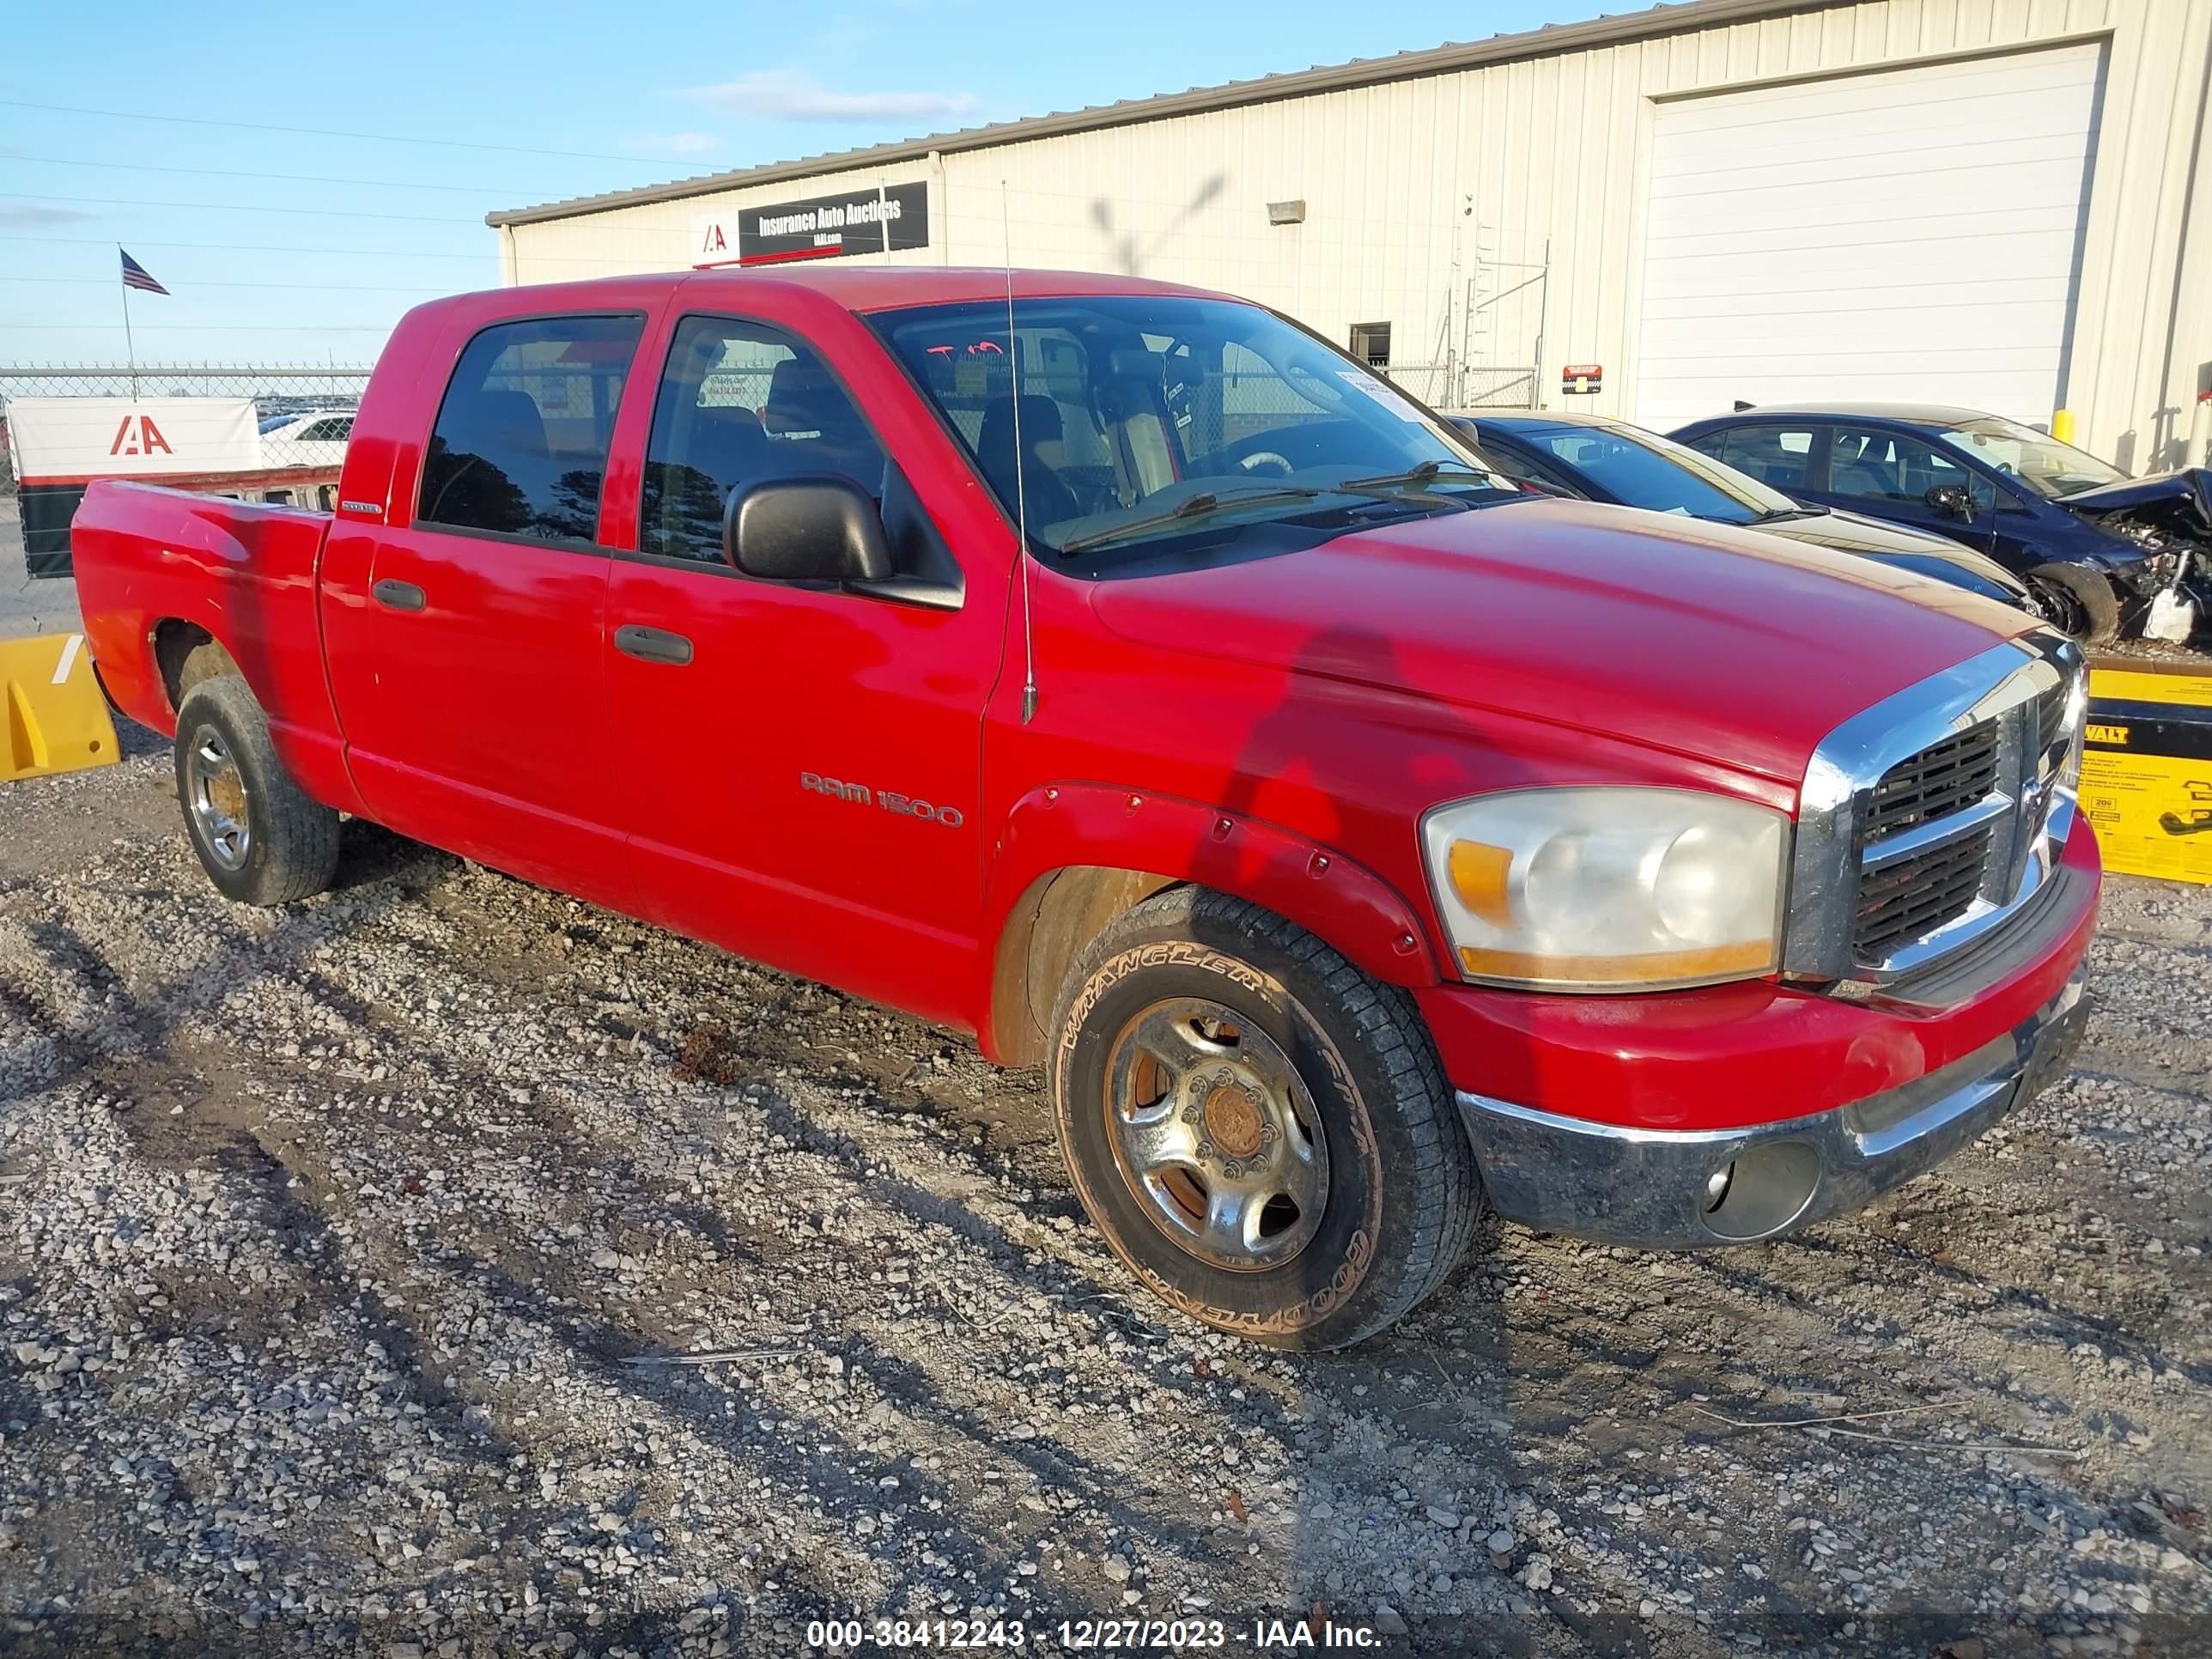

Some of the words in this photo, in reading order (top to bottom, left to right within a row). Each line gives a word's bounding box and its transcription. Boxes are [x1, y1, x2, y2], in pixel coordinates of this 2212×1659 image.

[759, 212, 816, 237] Insurance
[817, 207, 844, 229] Auto
[846, 199, 901, 224] Auctions
[800, 772, 871, 805] RAM
[877, 790, 963, 828] 1500
[1062, 944, 1264, 1051] WRANGLER
[1142, 1229, 1370, 1329] GOODYEAR
